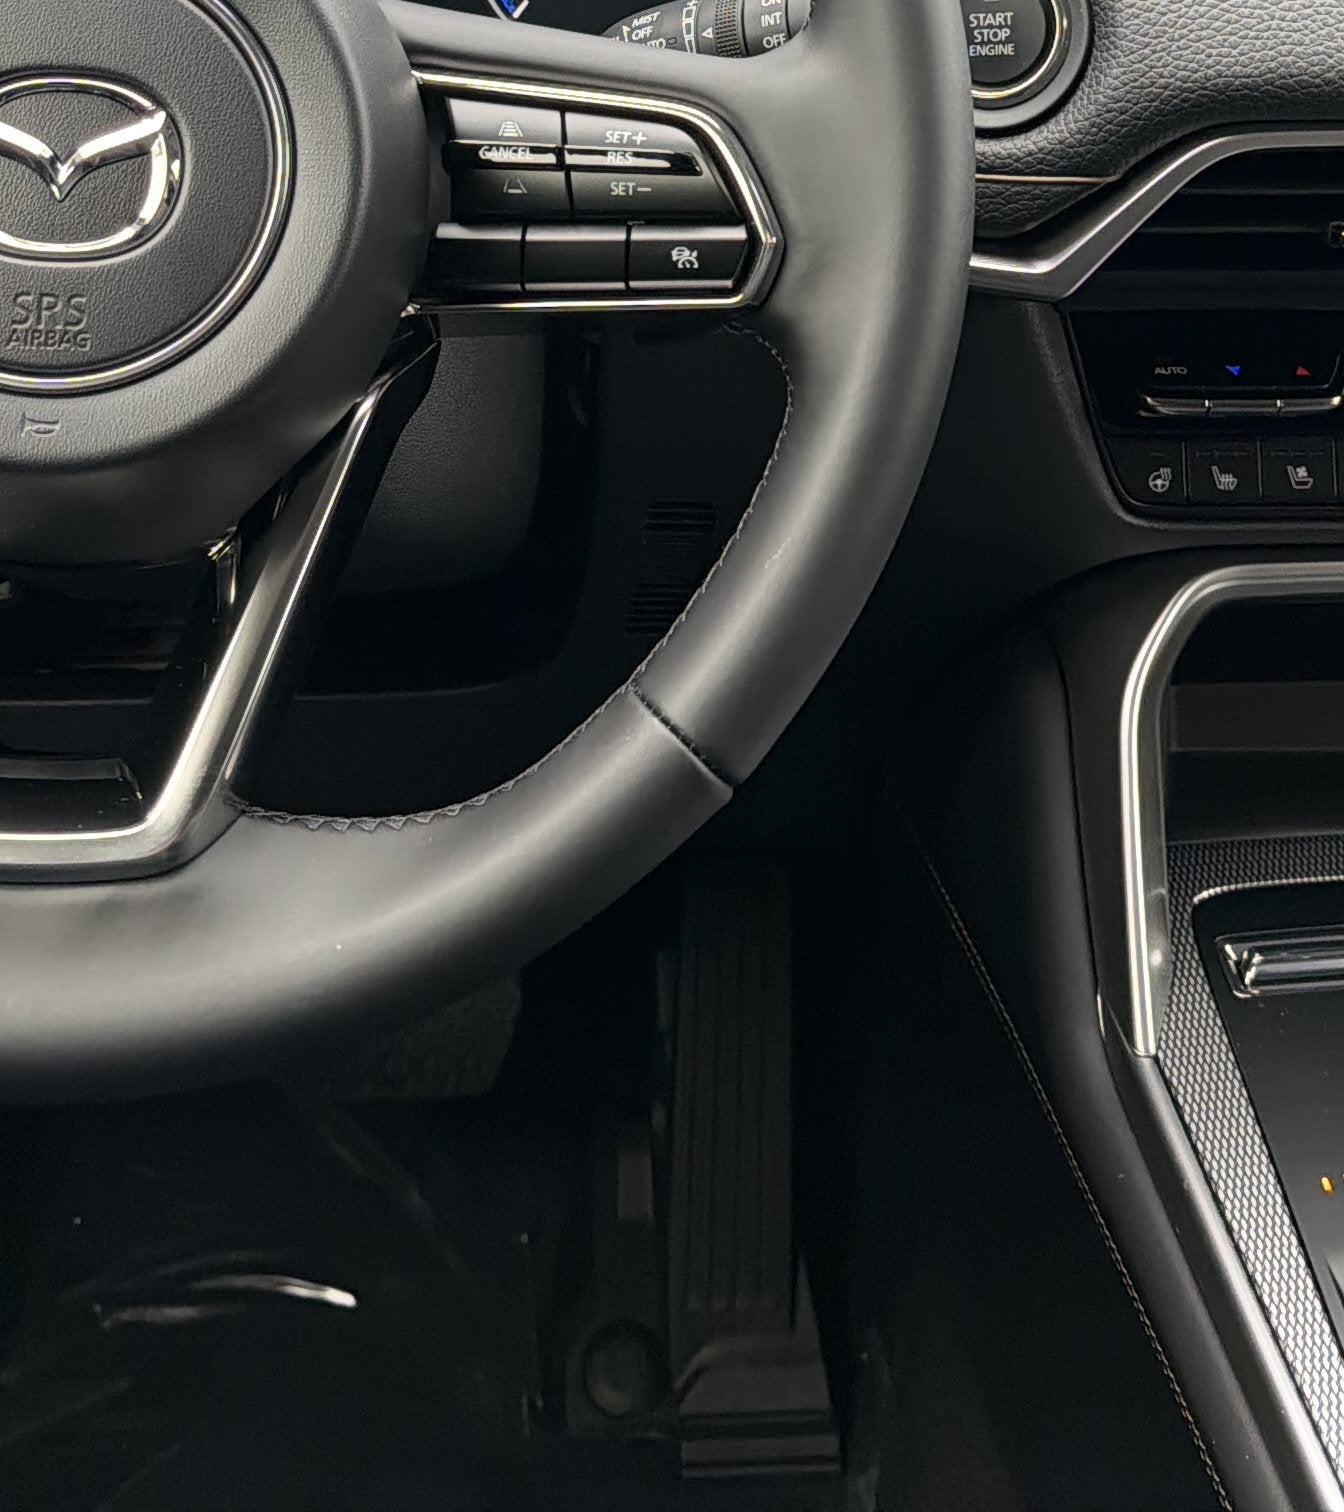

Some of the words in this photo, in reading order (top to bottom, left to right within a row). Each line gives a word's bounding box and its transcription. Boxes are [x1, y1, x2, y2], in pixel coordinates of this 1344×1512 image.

[761, 11, 783, 27] INT
[969, 12, 1014, 27] START
[632, 25, 654, 40] OFF
[973, 28, 1011, 43] STOP
[762, 33, 787, 49] OFF
[969, 44, 1015, 57] ENGINE
[478, 145, 532, 161] CANCEL
[11, 291, 88, 331] SRS
[6, 329, 92, 352] AIRBAG
[1154, 366, 1188, 376] AUTO
